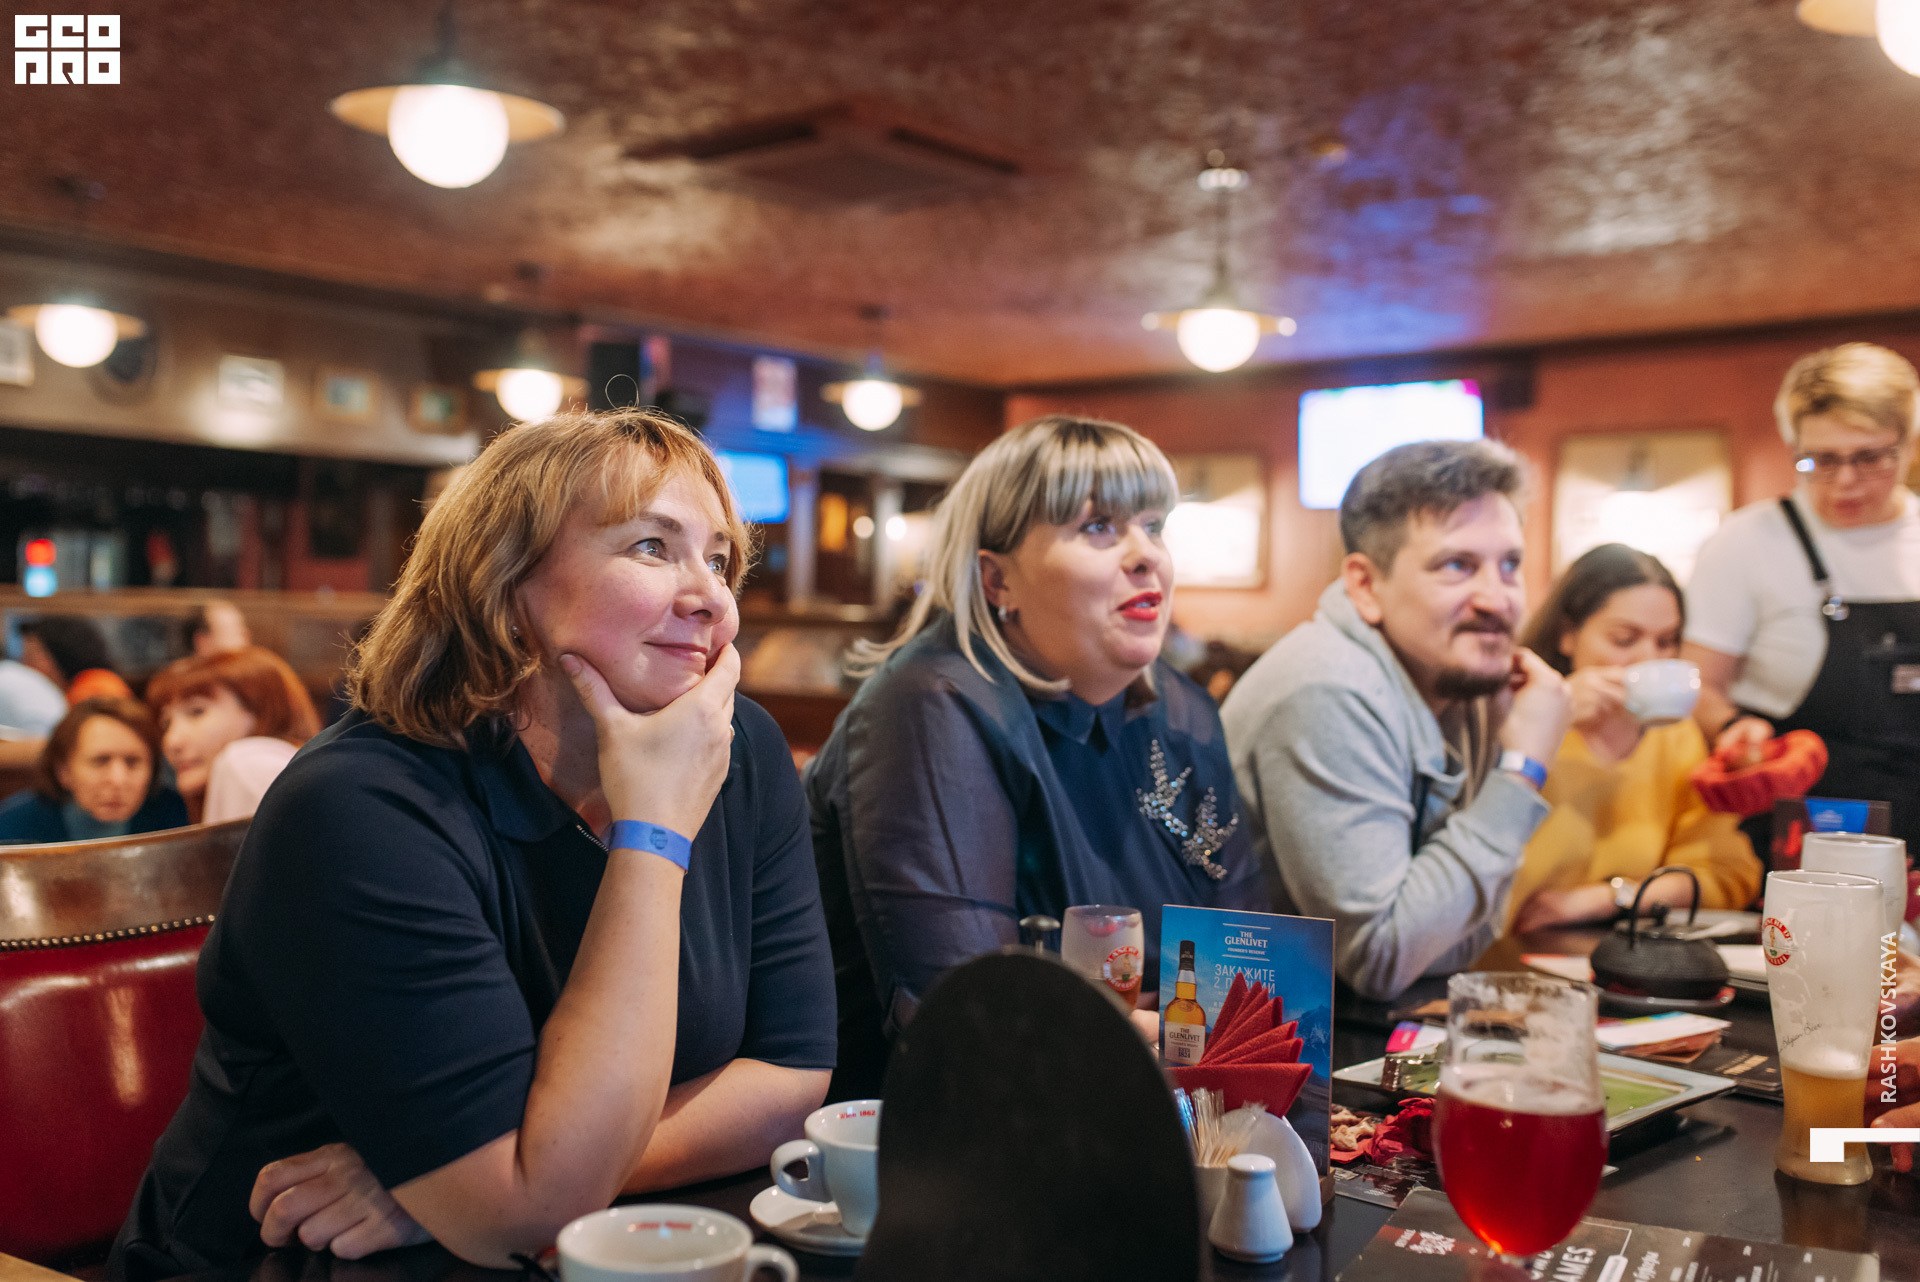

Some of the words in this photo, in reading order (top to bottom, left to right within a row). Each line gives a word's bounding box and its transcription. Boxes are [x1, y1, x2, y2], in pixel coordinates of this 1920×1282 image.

[1240, 930, 1253, 938] THE
[1224, 936, 1268, 948] GLENLIVET
[1213, 976, 1220, 989] 2
[1169, 1031, 1200, 1043] GLENLIVET
